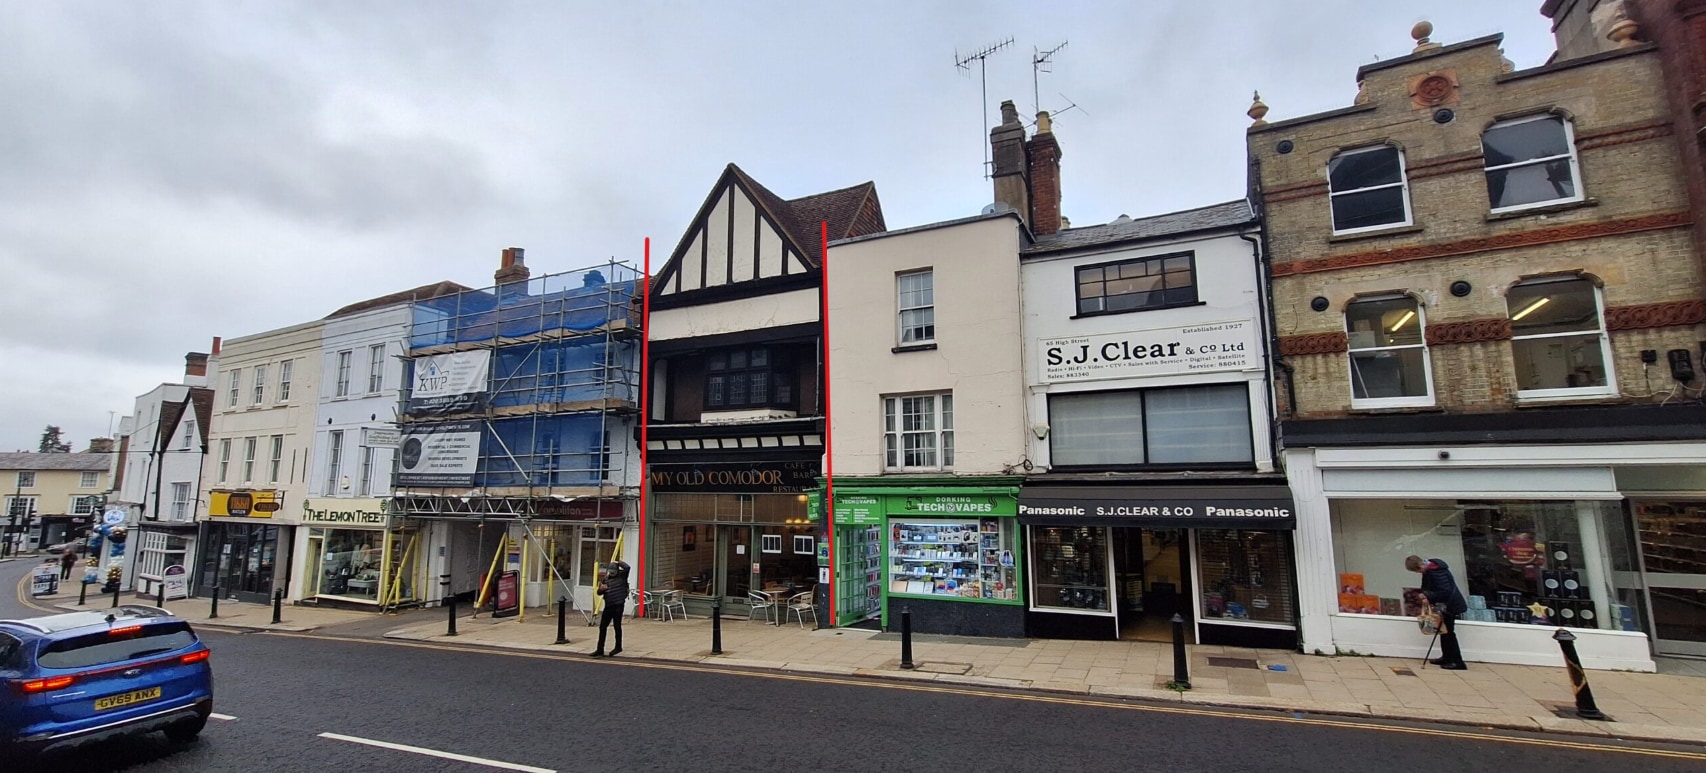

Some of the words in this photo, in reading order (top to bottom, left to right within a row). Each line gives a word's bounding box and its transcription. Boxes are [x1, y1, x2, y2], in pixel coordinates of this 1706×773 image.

[1183, 326, 1222, 334] Established
[1185, 347, 1195, 355] &
[1221, 342, 1245, 353] Ltd
[417, 376, 447, 391] KWP
[652, 471, 673, 486] MY
[677, 470, 705, 486] OLD
[708, 469, 784, 485] COMODOR
[917, 503, 945, 512] TECH
[956, 503, 992, 512] VAPES
[1019, 505, 1086, 516] Panasonic
[1096, 506, 1159, 516] S.J.CLEAR
[1162, 506, 1171, 516] &
[1174, 506, 1194, 516] CO
[1206, 506, 1290, 518] Panasonic
[307, 509, 324, 521] THE
[325, 509, 355, 522] LEMON
[356, 510, 380, 523] TREE
[100, 694, 132, 708] GV69
[135, 688, 156, 701] ANX
